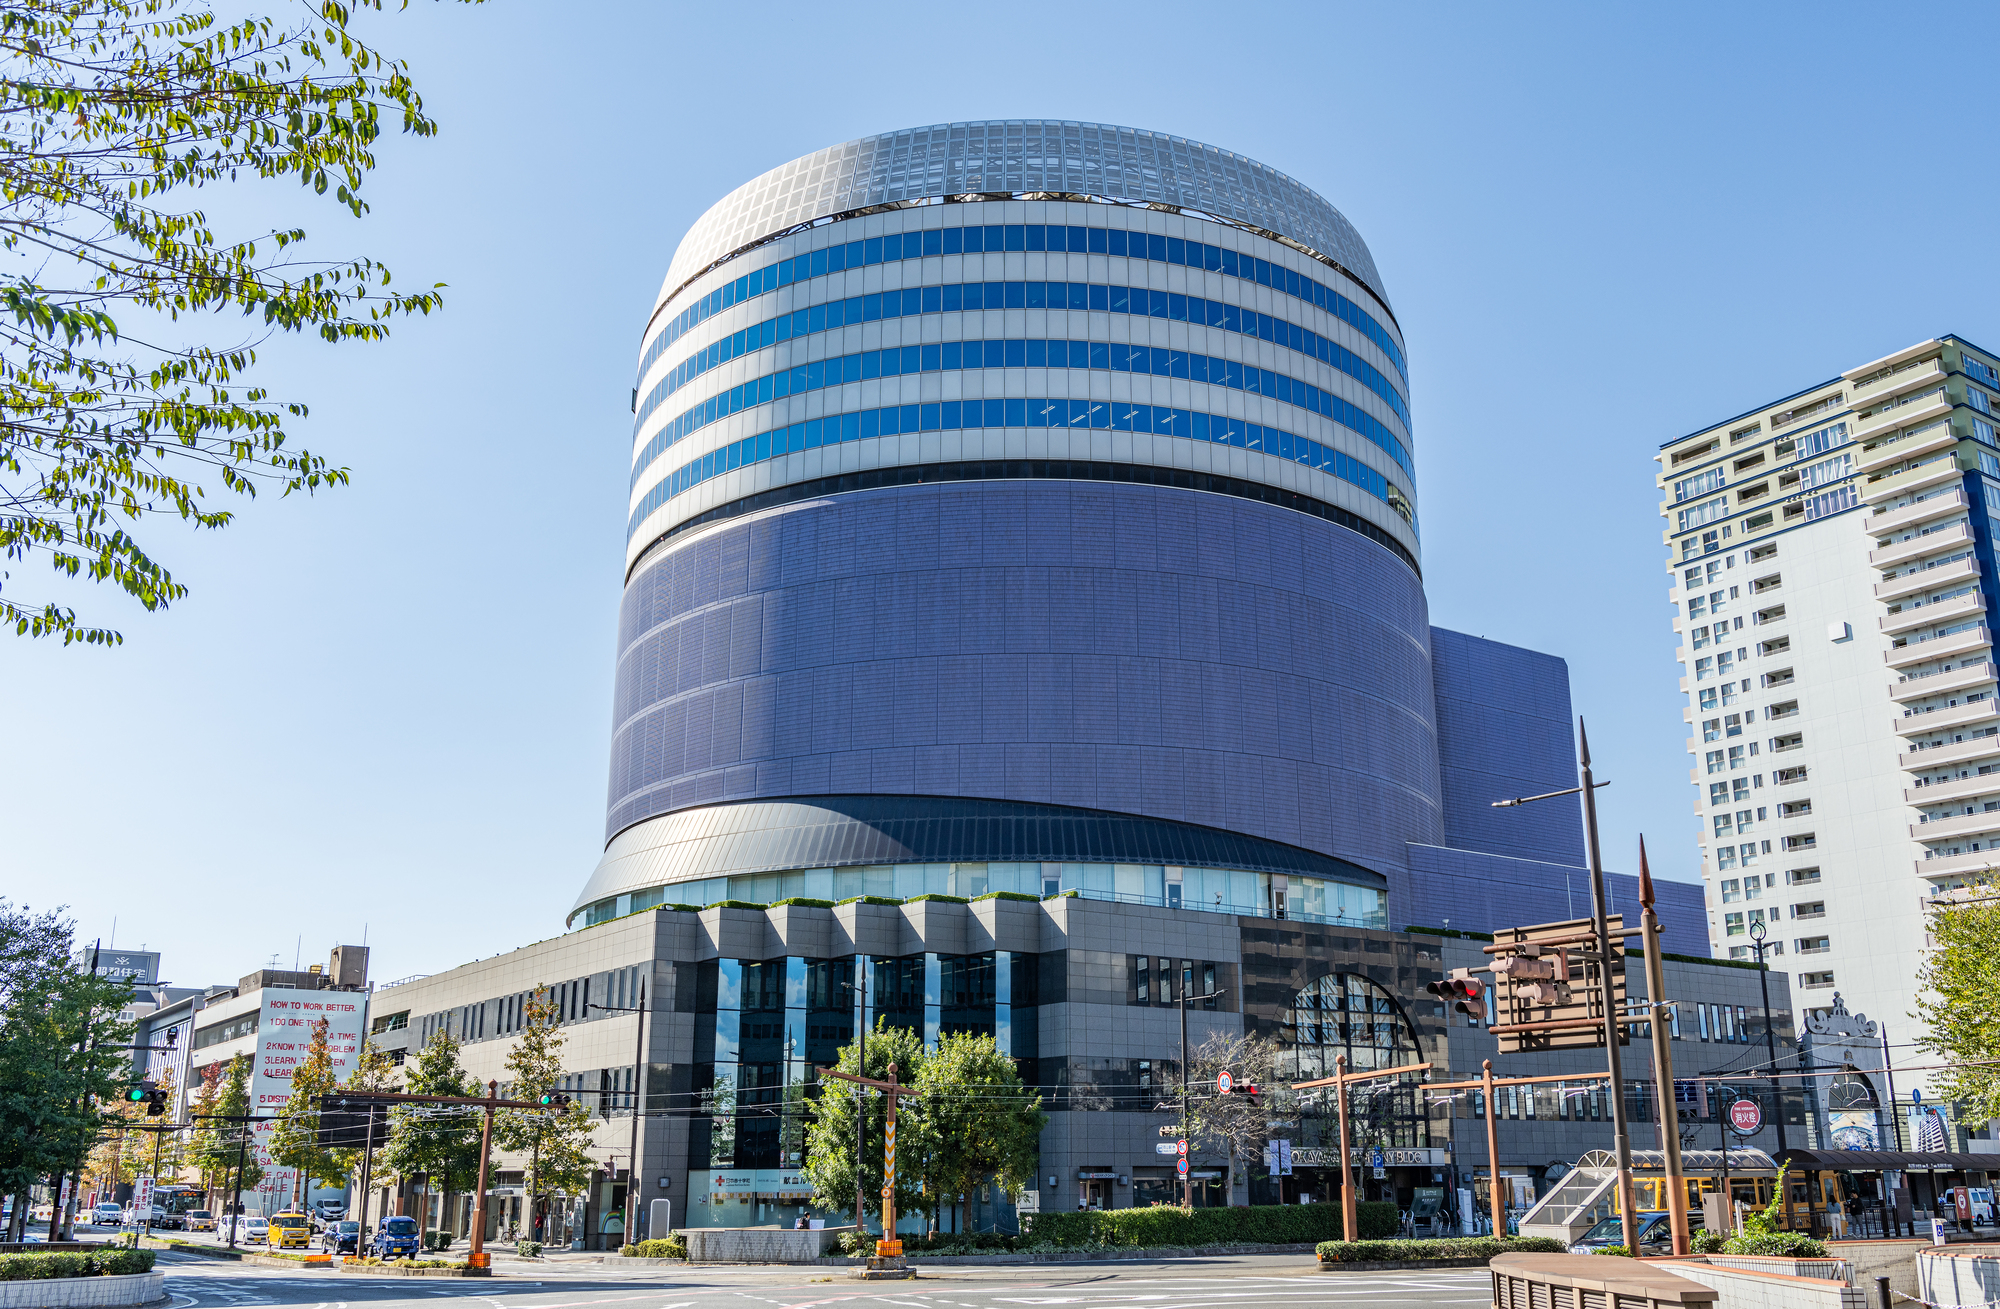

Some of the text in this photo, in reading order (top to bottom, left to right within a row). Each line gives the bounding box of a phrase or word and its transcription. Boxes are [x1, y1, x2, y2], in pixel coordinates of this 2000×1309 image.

[270, 1000, 288, 1009] HOW
[290, 1001, 301, 1009] TO
[303, 1002, 323, 1011] WORK
[275, 1018, 286, 1026] DO
[288, 1018, 304, 1027] ONE
[337, 1032, 356, 1041] TIME
[1220, 1077, 1230, 1088] 40
[1735, 1111, 1757, 1124] 消火栓
